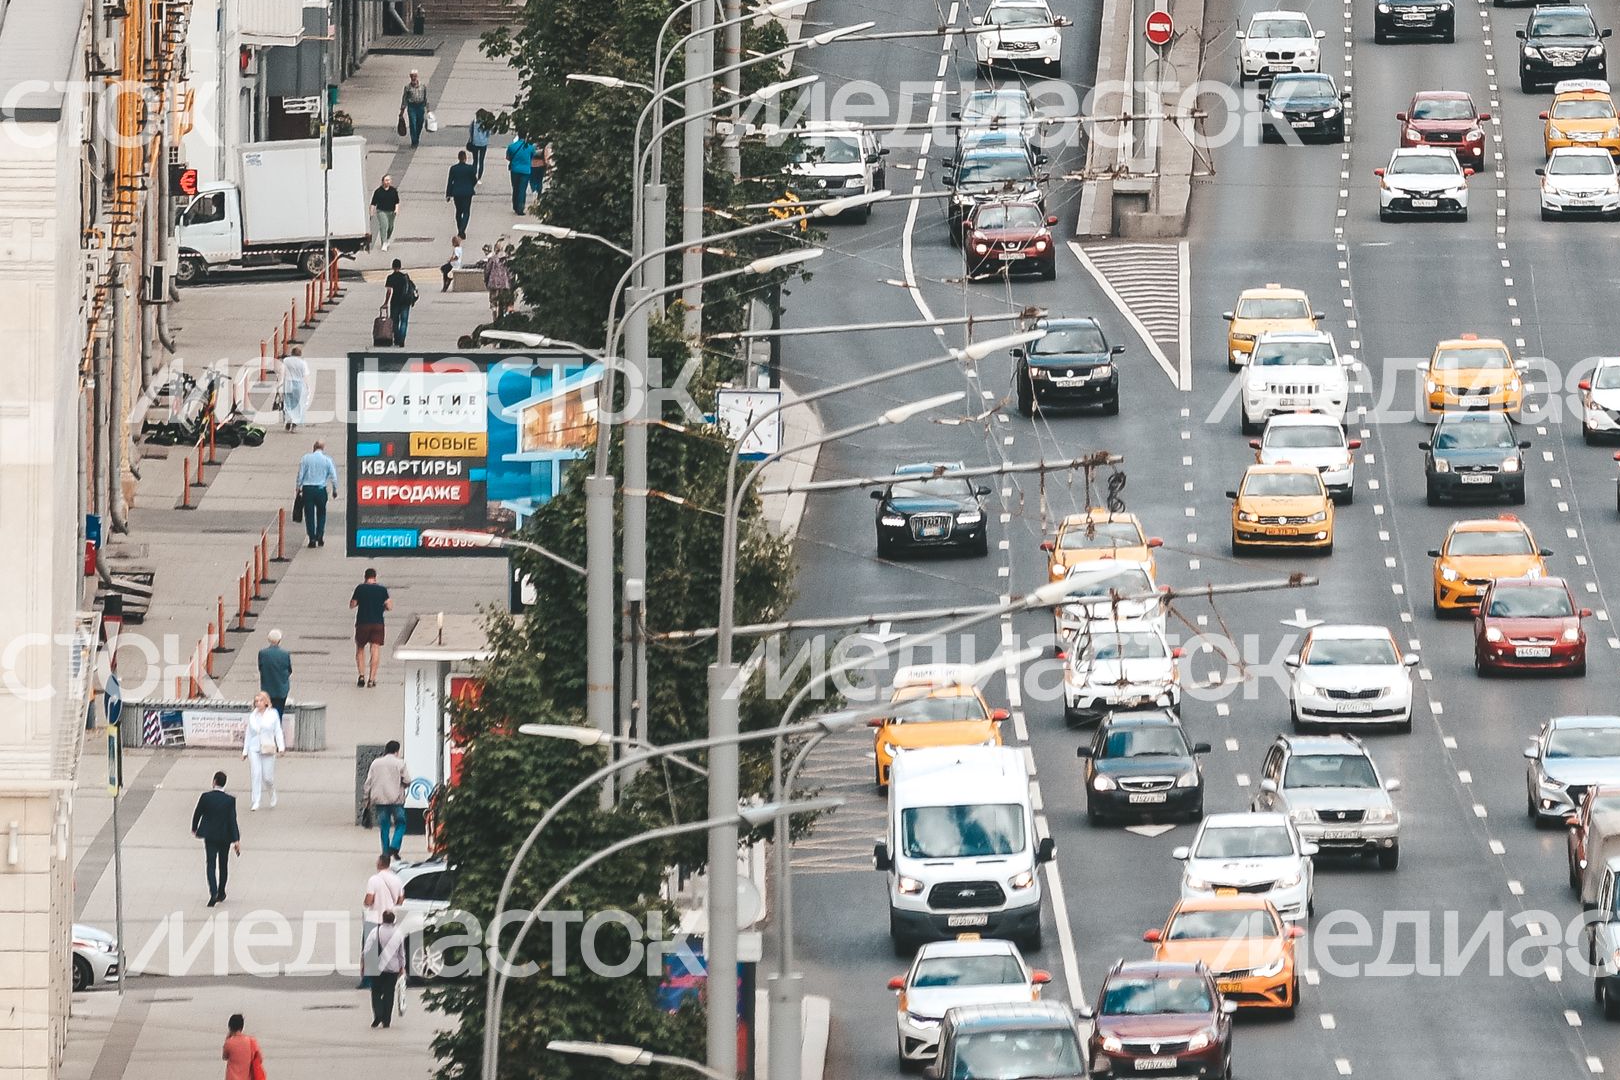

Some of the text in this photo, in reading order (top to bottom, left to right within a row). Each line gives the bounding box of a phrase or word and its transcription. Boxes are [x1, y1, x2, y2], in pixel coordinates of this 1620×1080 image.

[368, 395, 477, 406] СОБЫТИЕ
[417, 437, 478, 451] НОВЫЕ
[361, 459, 462, 476] КВАРТИРЫ
[361, 485, 461, 503] В ПРОДАЖЕ
[360, 533, 412, 547] ДОНСТРОЙ
